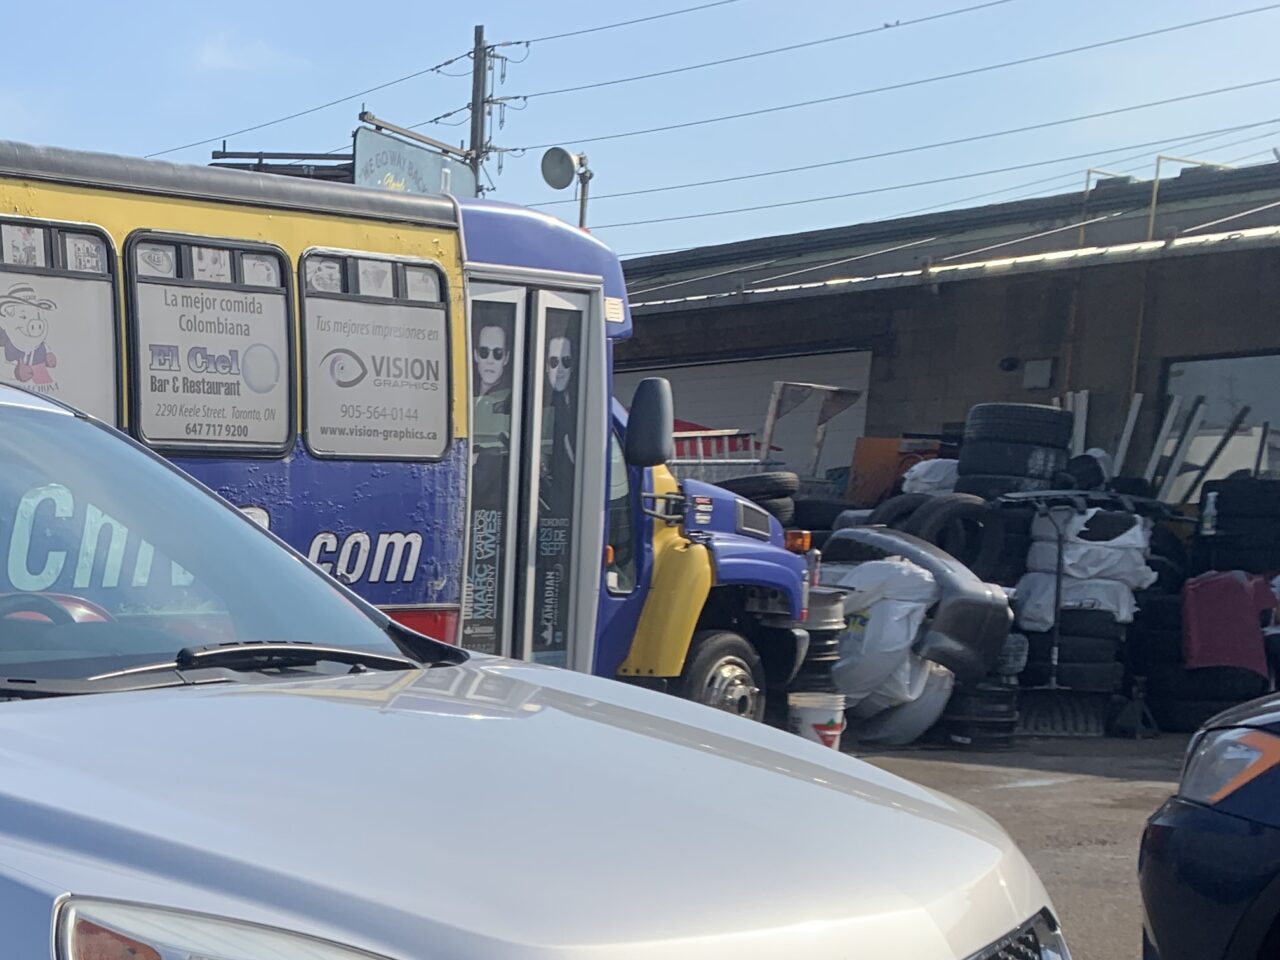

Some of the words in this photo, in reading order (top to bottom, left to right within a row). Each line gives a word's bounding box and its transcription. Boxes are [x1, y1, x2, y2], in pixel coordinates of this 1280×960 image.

[164, 288, 178, 307] La
[181, 292, 217, 314] mejor
[220, 296, 263, 315] comida
[179, 314, 251, 337] Colombiana
[316, 315, 331, 333] Tus
[333, 319, 370, 338] mejores
[427, 329, 439, 341] en
[149, 344, 181, 372] El
[371, 355, 439, 382] VISION
[150, 375, 169, 393] Bar
[172, 376, 179, 393] &
[182, 376, 241, 397] Restaurant
[373, 378, 439, 392] GRAPHICS
[155, 403, 178, 417] 2290
[179, 404, 200, 418] Keele
[263, 408, 276, 421] ON
[340, 403, 419, 421] 905-564-0144
[185, 423, 203, 435] 647
[206, 423, 223, 436] 717
[225, 425, 249, 437] 9200
[320, 425, 438, 441] www.vision-graphics.ca
[474, 509, 486, 560] CARLOS
[484, 510, 497, 559] VIVES
[539, 528, 553, 541] 23
[554, 530, 568, 541] DE
[474, 563, 487, 619] MARC
[484, 563, 495, 619] ANTHONY
[544, 571, 555, 626] CANADIAN
